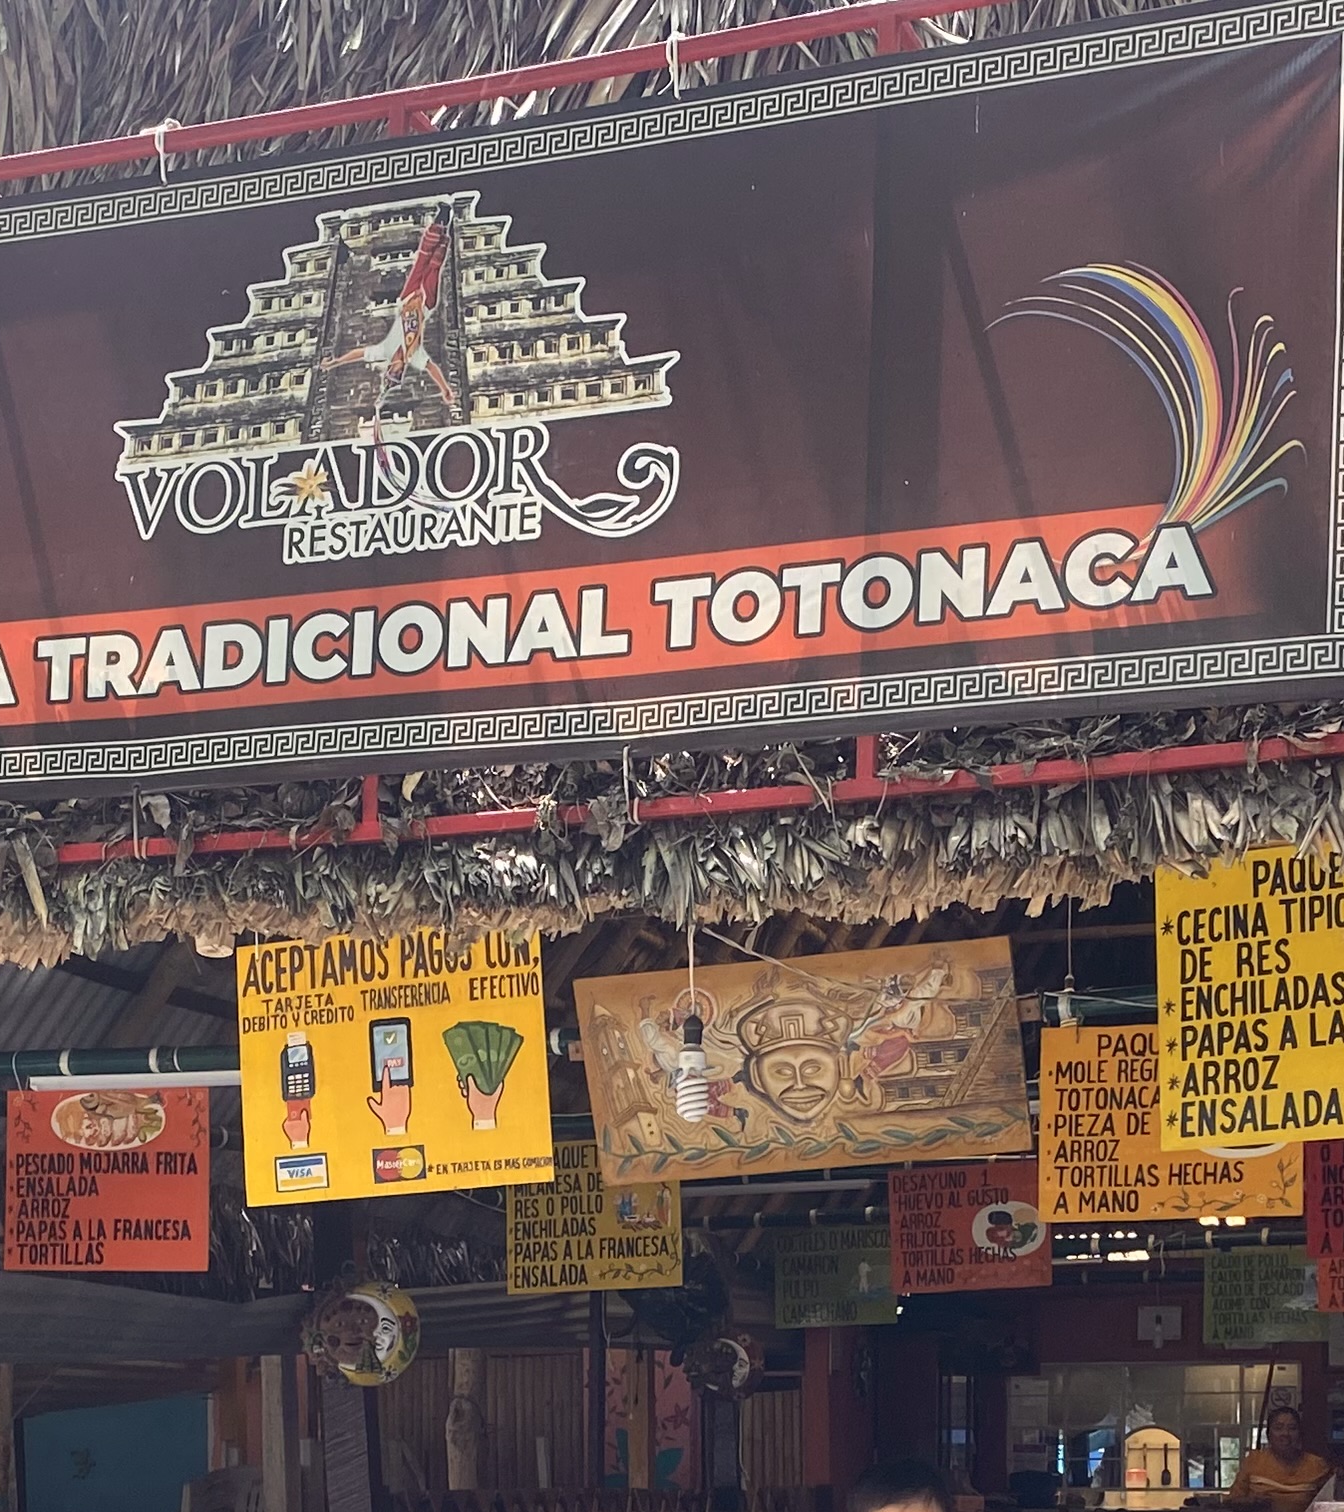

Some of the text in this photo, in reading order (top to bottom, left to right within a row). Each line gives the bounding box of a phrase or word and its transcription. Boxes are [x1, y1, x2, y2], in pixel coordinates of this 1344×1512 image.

[118, 421, 678, 542] VOLADOR
[285, 503, 541, 562] RESTAURANTE
[38, 583, 630, 700] TRADICIONAL
[655, 527, 1213, 644] TOTONACA
[1177, 904, 1268, 944] CECINA
[243, 940, 388, 998] ACEPTAMOS
[1181, 939, 1290, 984] DE RES
[360, 981, 450, 1012] TRANSFERENCIA
[469, 972, 539, 1000] EFECTIVO
[262, 993, 334, 1014] TARJETA
[243, 1006, 354, 1034] DEBITO Y CREDITO
[1181, 1019, 1268, 1060] PAPAS
[1279, 1015, 1297, 1050] A
[1055, 1059, 1108, 1085] MOLE
[1182, 1056, 1279, 1097] ARROZ
[1181, 1088, 1343, 1137] ENSALADA
[1054, 1112, 1150, 1137] PIEZA DE
[1054, 1140, 1120, 1162] ARROZ
[1321, 1145, 1330, 1162] O
[16, 1152, 198, 1175] PESCADO MOJARRA FRITA
[287, 1168, 312, 1178] VISA
[1055, 1161, 1244, 1187] TORTILLAS HECHAS
[16, 1176, 99, 1198] ENSALADA
[588, 1172, 604, 1192] DE
[893, 1172, 991, 1193] DESAYUNO 1
[18, 1199, 70, 1219] ARROZ
[515, 1195, 602, 1219] RES O POLLO
[898, 1189, 1008, 1211] HUEVO AL GUSTO
[1054, 1190, 1138, 1214] A MANO
[16, 1219, 191, 1241] PAPAS A LA FRANCESA
[514, 1218, 596, 1240] ENCHILADAS
[900, 1212, 941, 1229] ARROZ
[514, 1237, 669, 1263] PAPAS A LA FRANCESA
[900, 1231, 954, 1248] FRIJOLES
[1320, 1233, 1331, 1253] A
[17, 1243, 104, 1265] TORTILLAS
[902, 1247, 1016, 1268] TORTILLAS HECHAS
[514, 1265, 587, 1288] ENSALADA
[903, 1269, 953, 1287] A MANO
[1329, 1294, 1338, 1308] A
